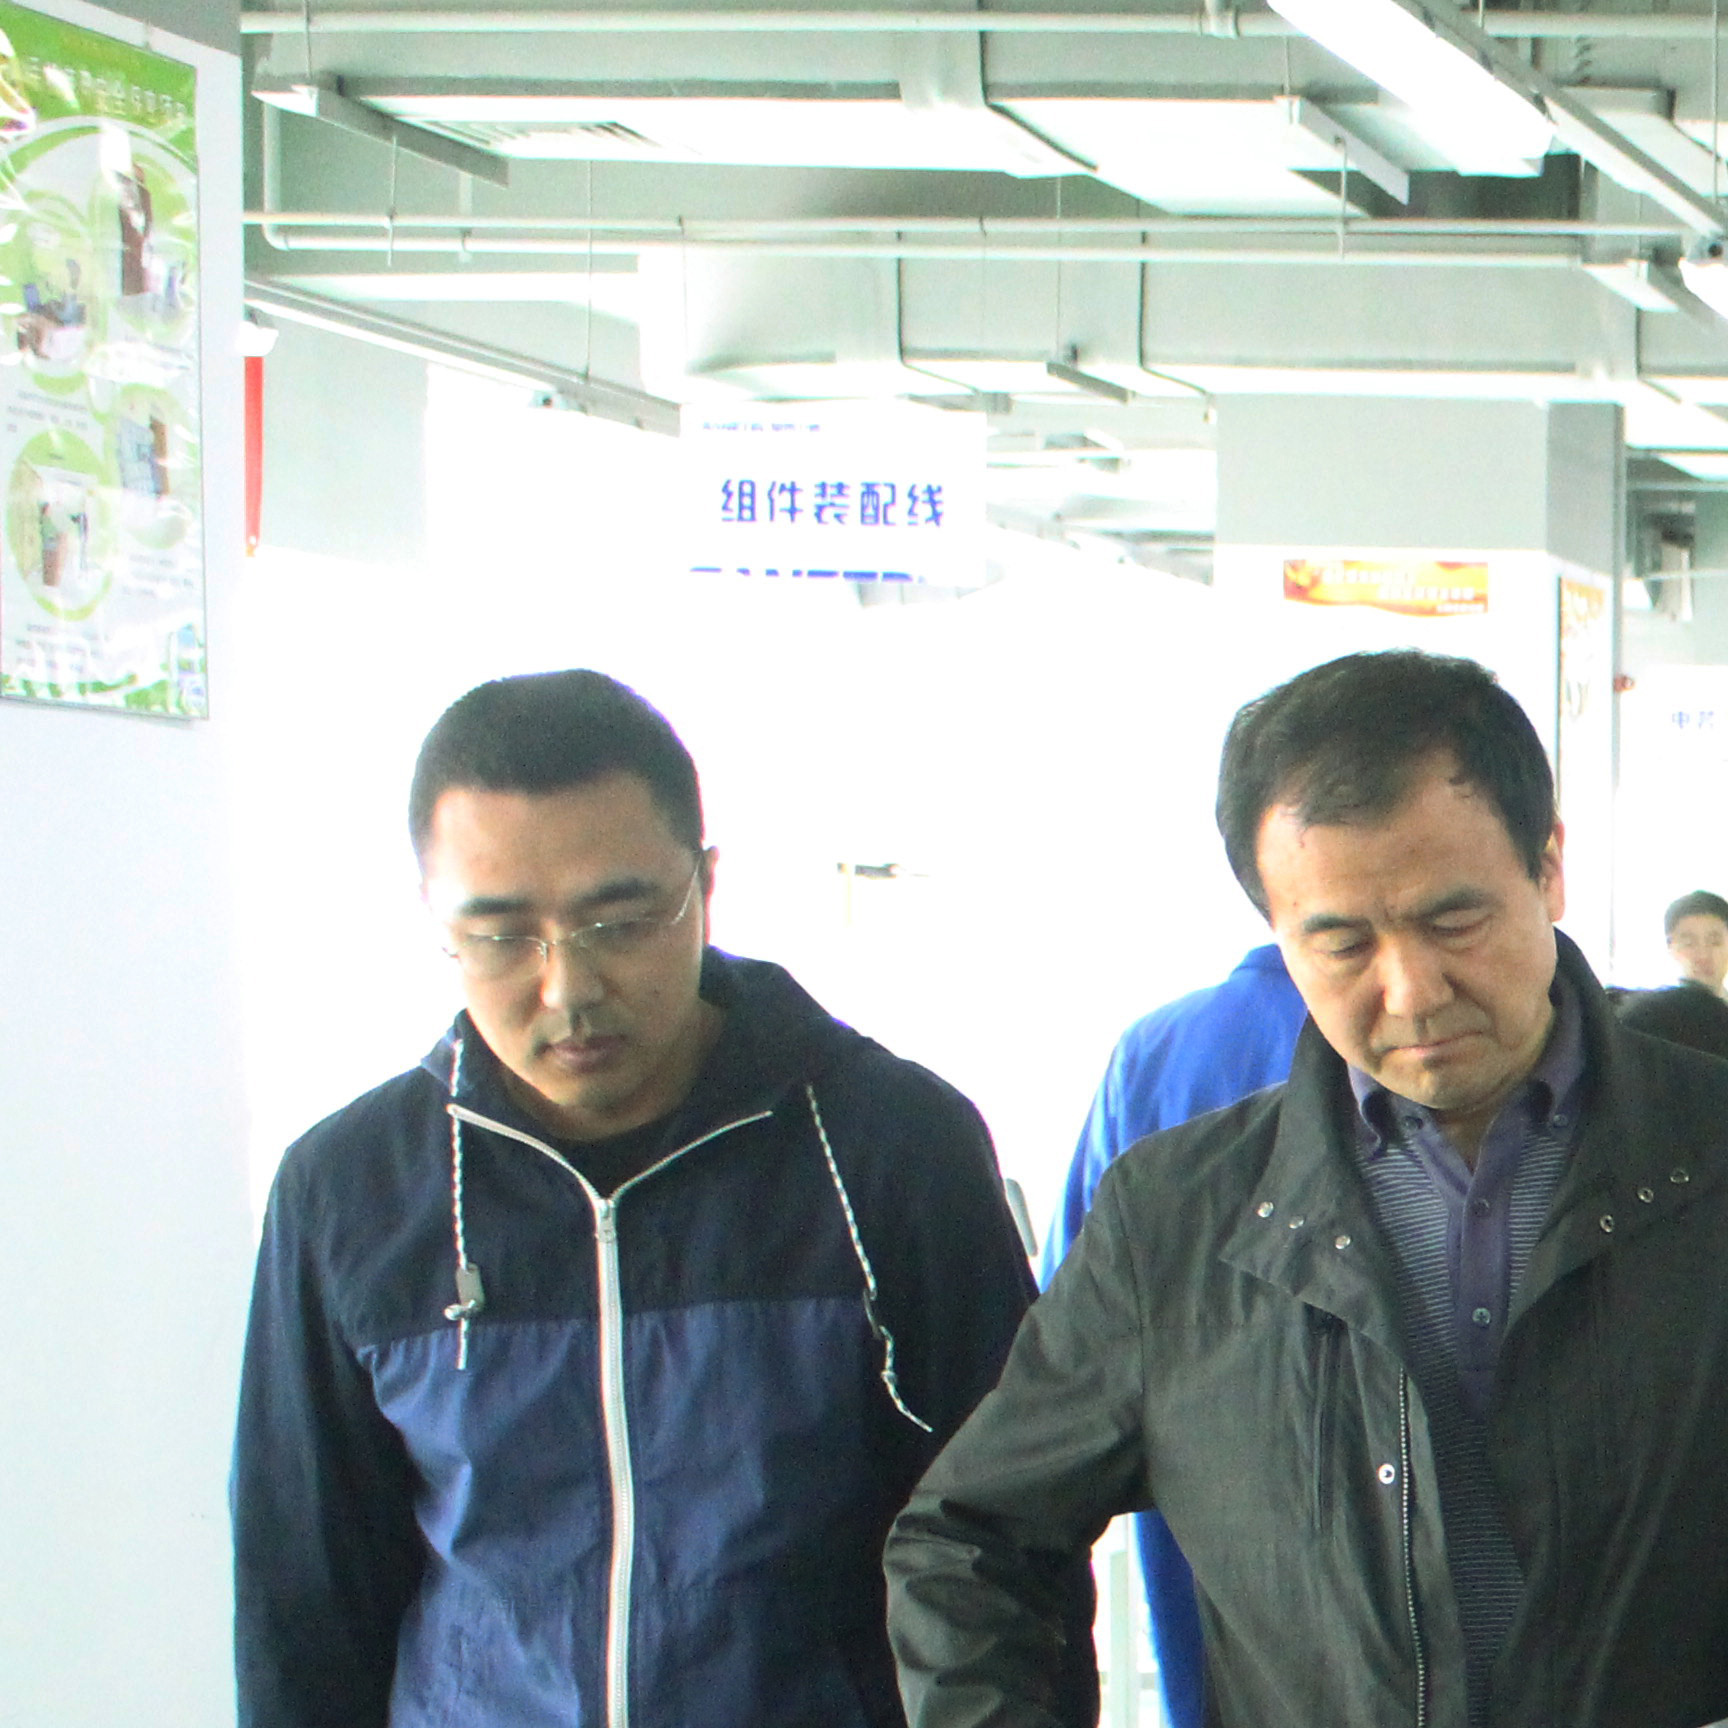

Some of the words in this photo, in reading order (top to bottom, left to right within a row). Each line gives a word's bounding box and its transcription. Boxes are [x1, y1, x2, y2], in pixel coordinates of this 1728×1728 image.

[720, 478, 944, 528] 组件装配线
